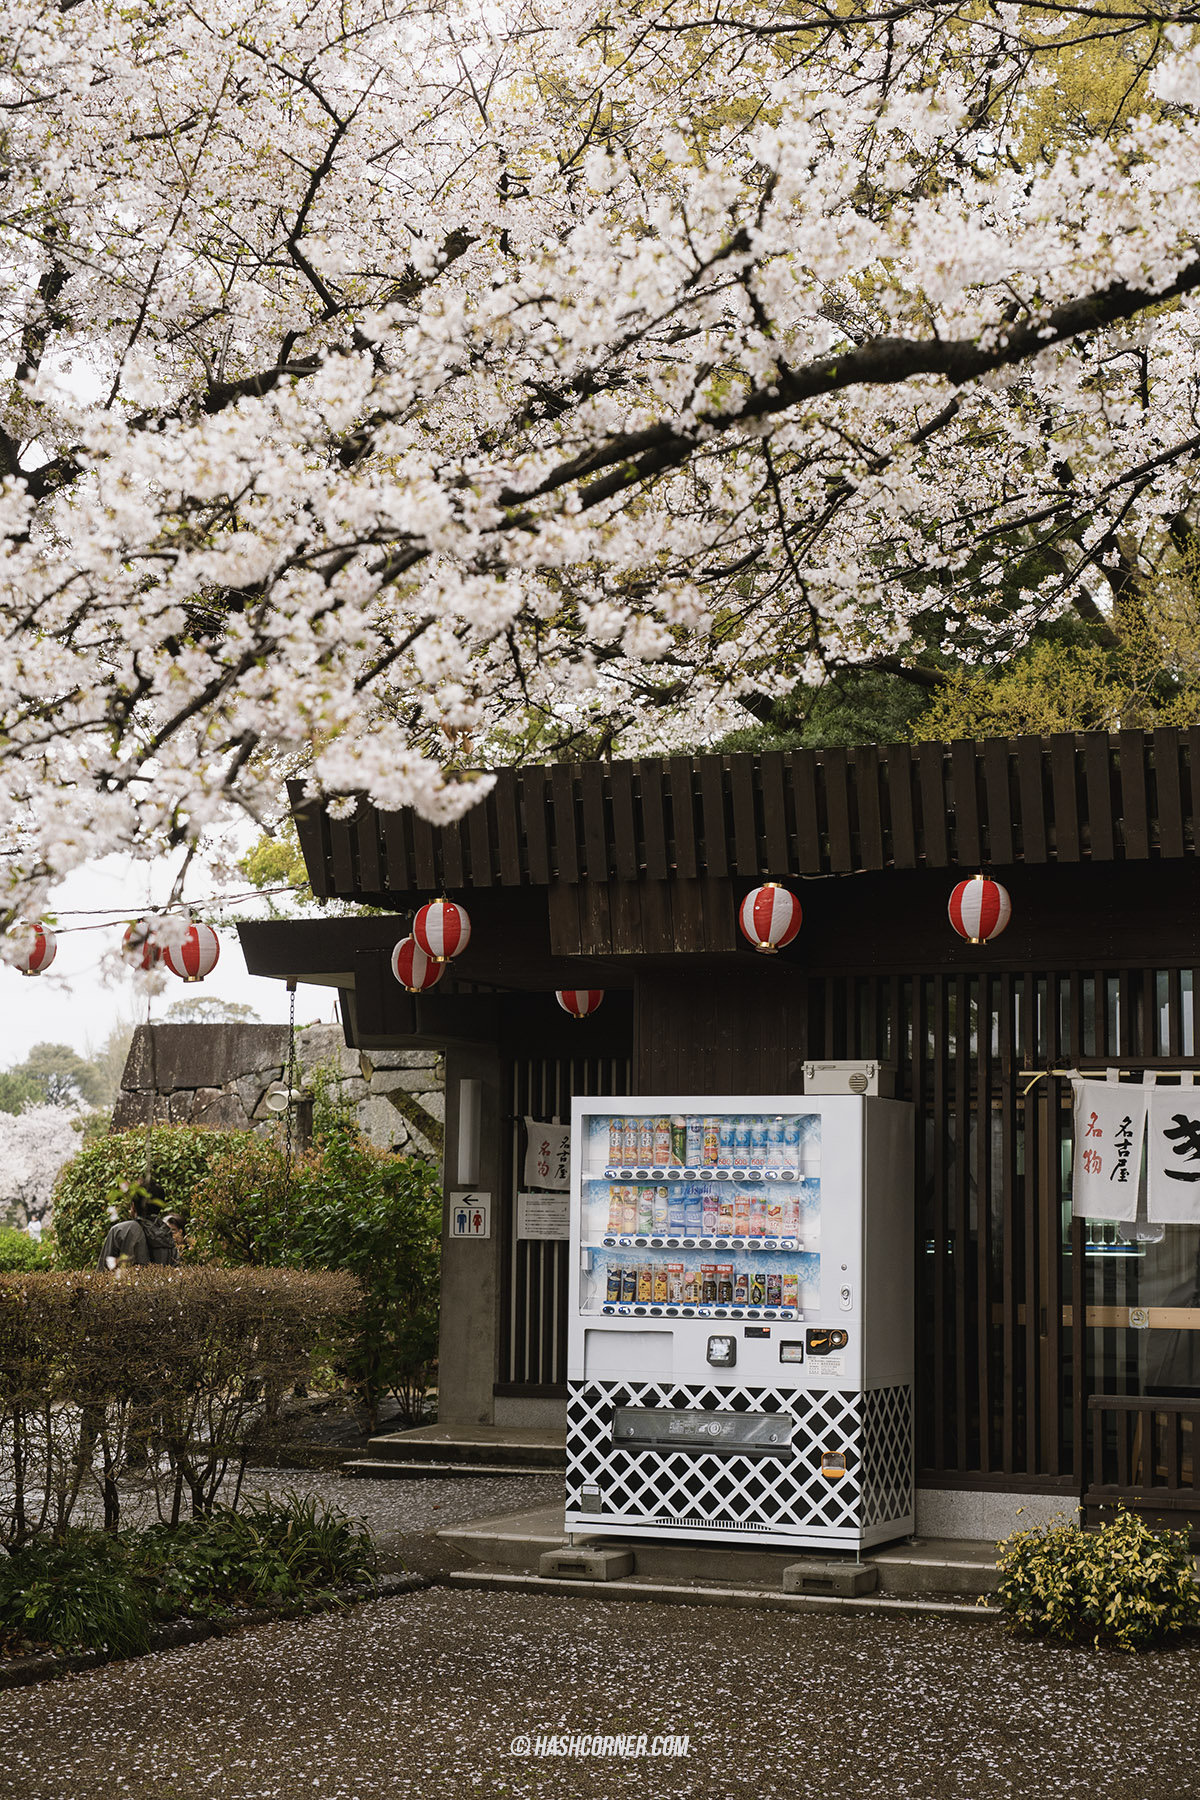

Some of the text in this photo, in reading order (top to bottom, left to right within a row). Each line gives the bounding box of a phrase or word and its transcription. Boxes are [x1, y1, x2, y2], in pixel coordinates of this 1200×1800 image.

[1082, 1112, 1103, 1174] 名物
[1110, 1116, 1133, 1182] 名古屋
